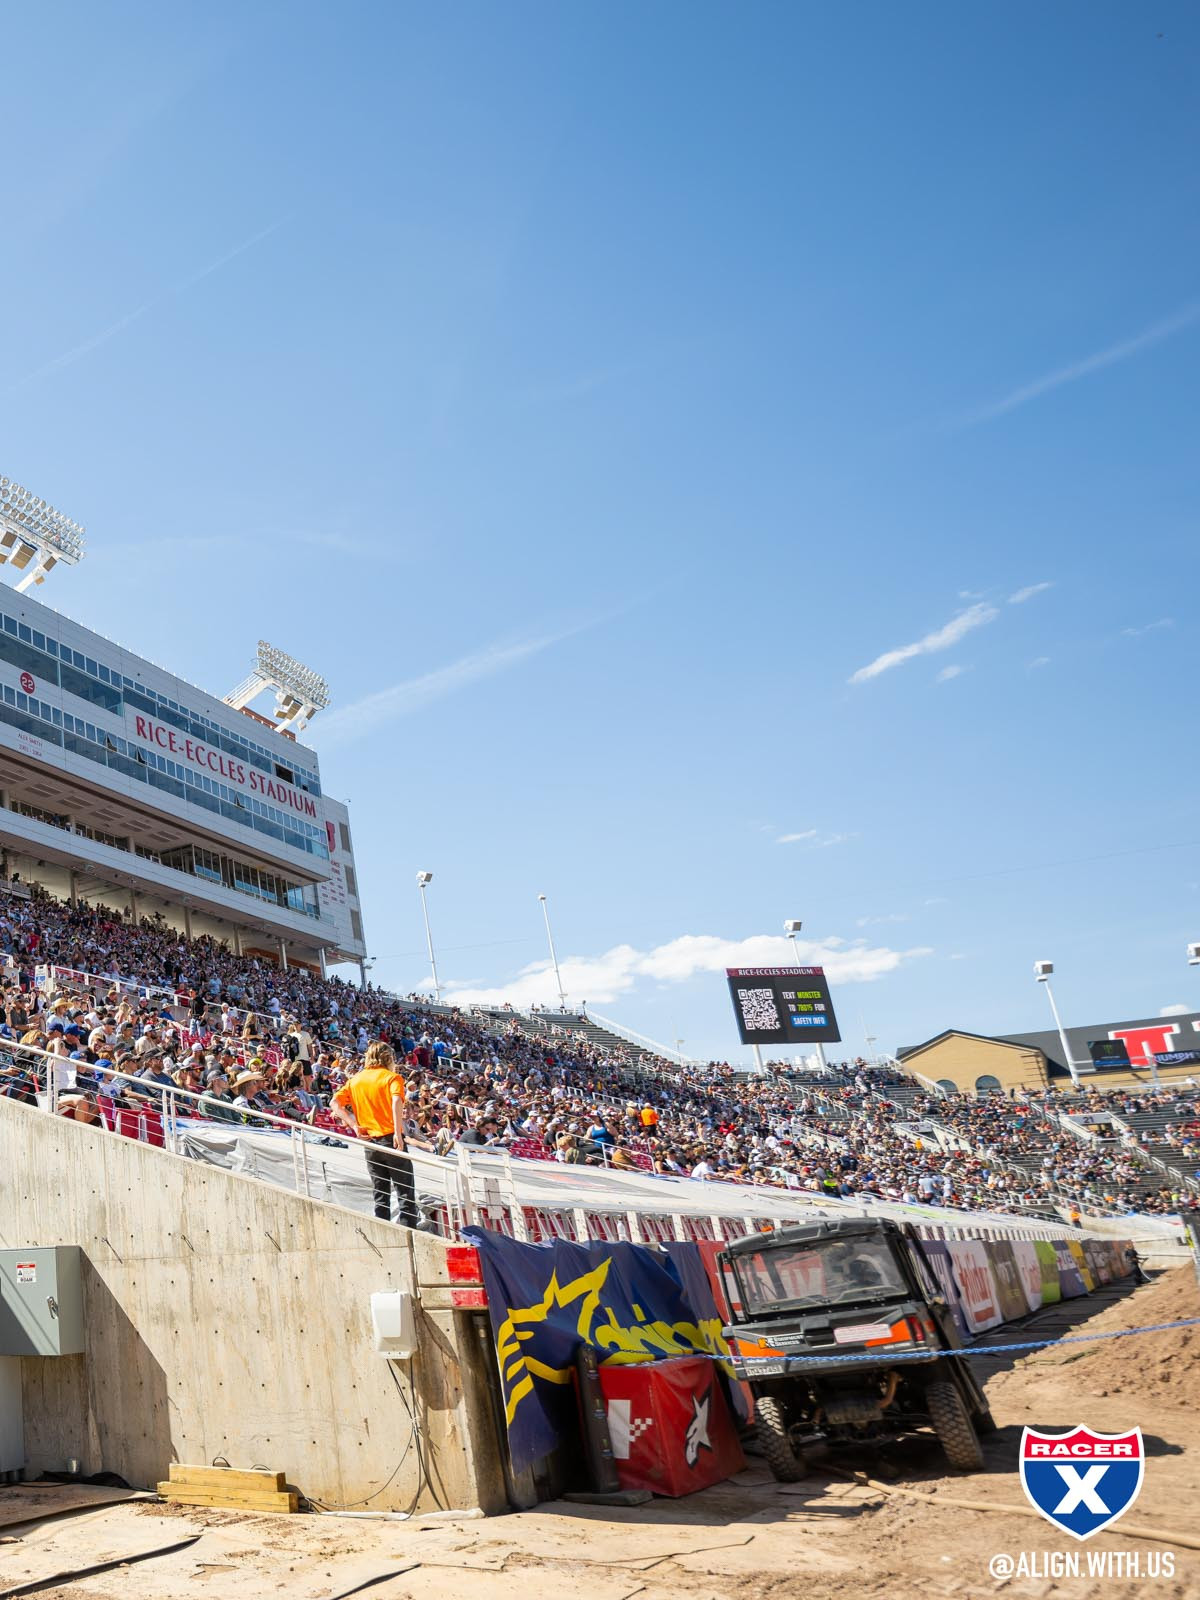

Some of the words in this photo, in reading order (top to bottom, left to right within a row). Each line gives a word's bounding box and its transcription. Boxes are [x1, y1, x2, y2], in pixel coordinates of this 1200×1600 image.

[21, 676, 34, 690] 22
[135, 715, 246, 785] RICE-ECCLES
[249, 770, 317, 818] STADIUM
[812, 1016, 826, 1024] INFO
